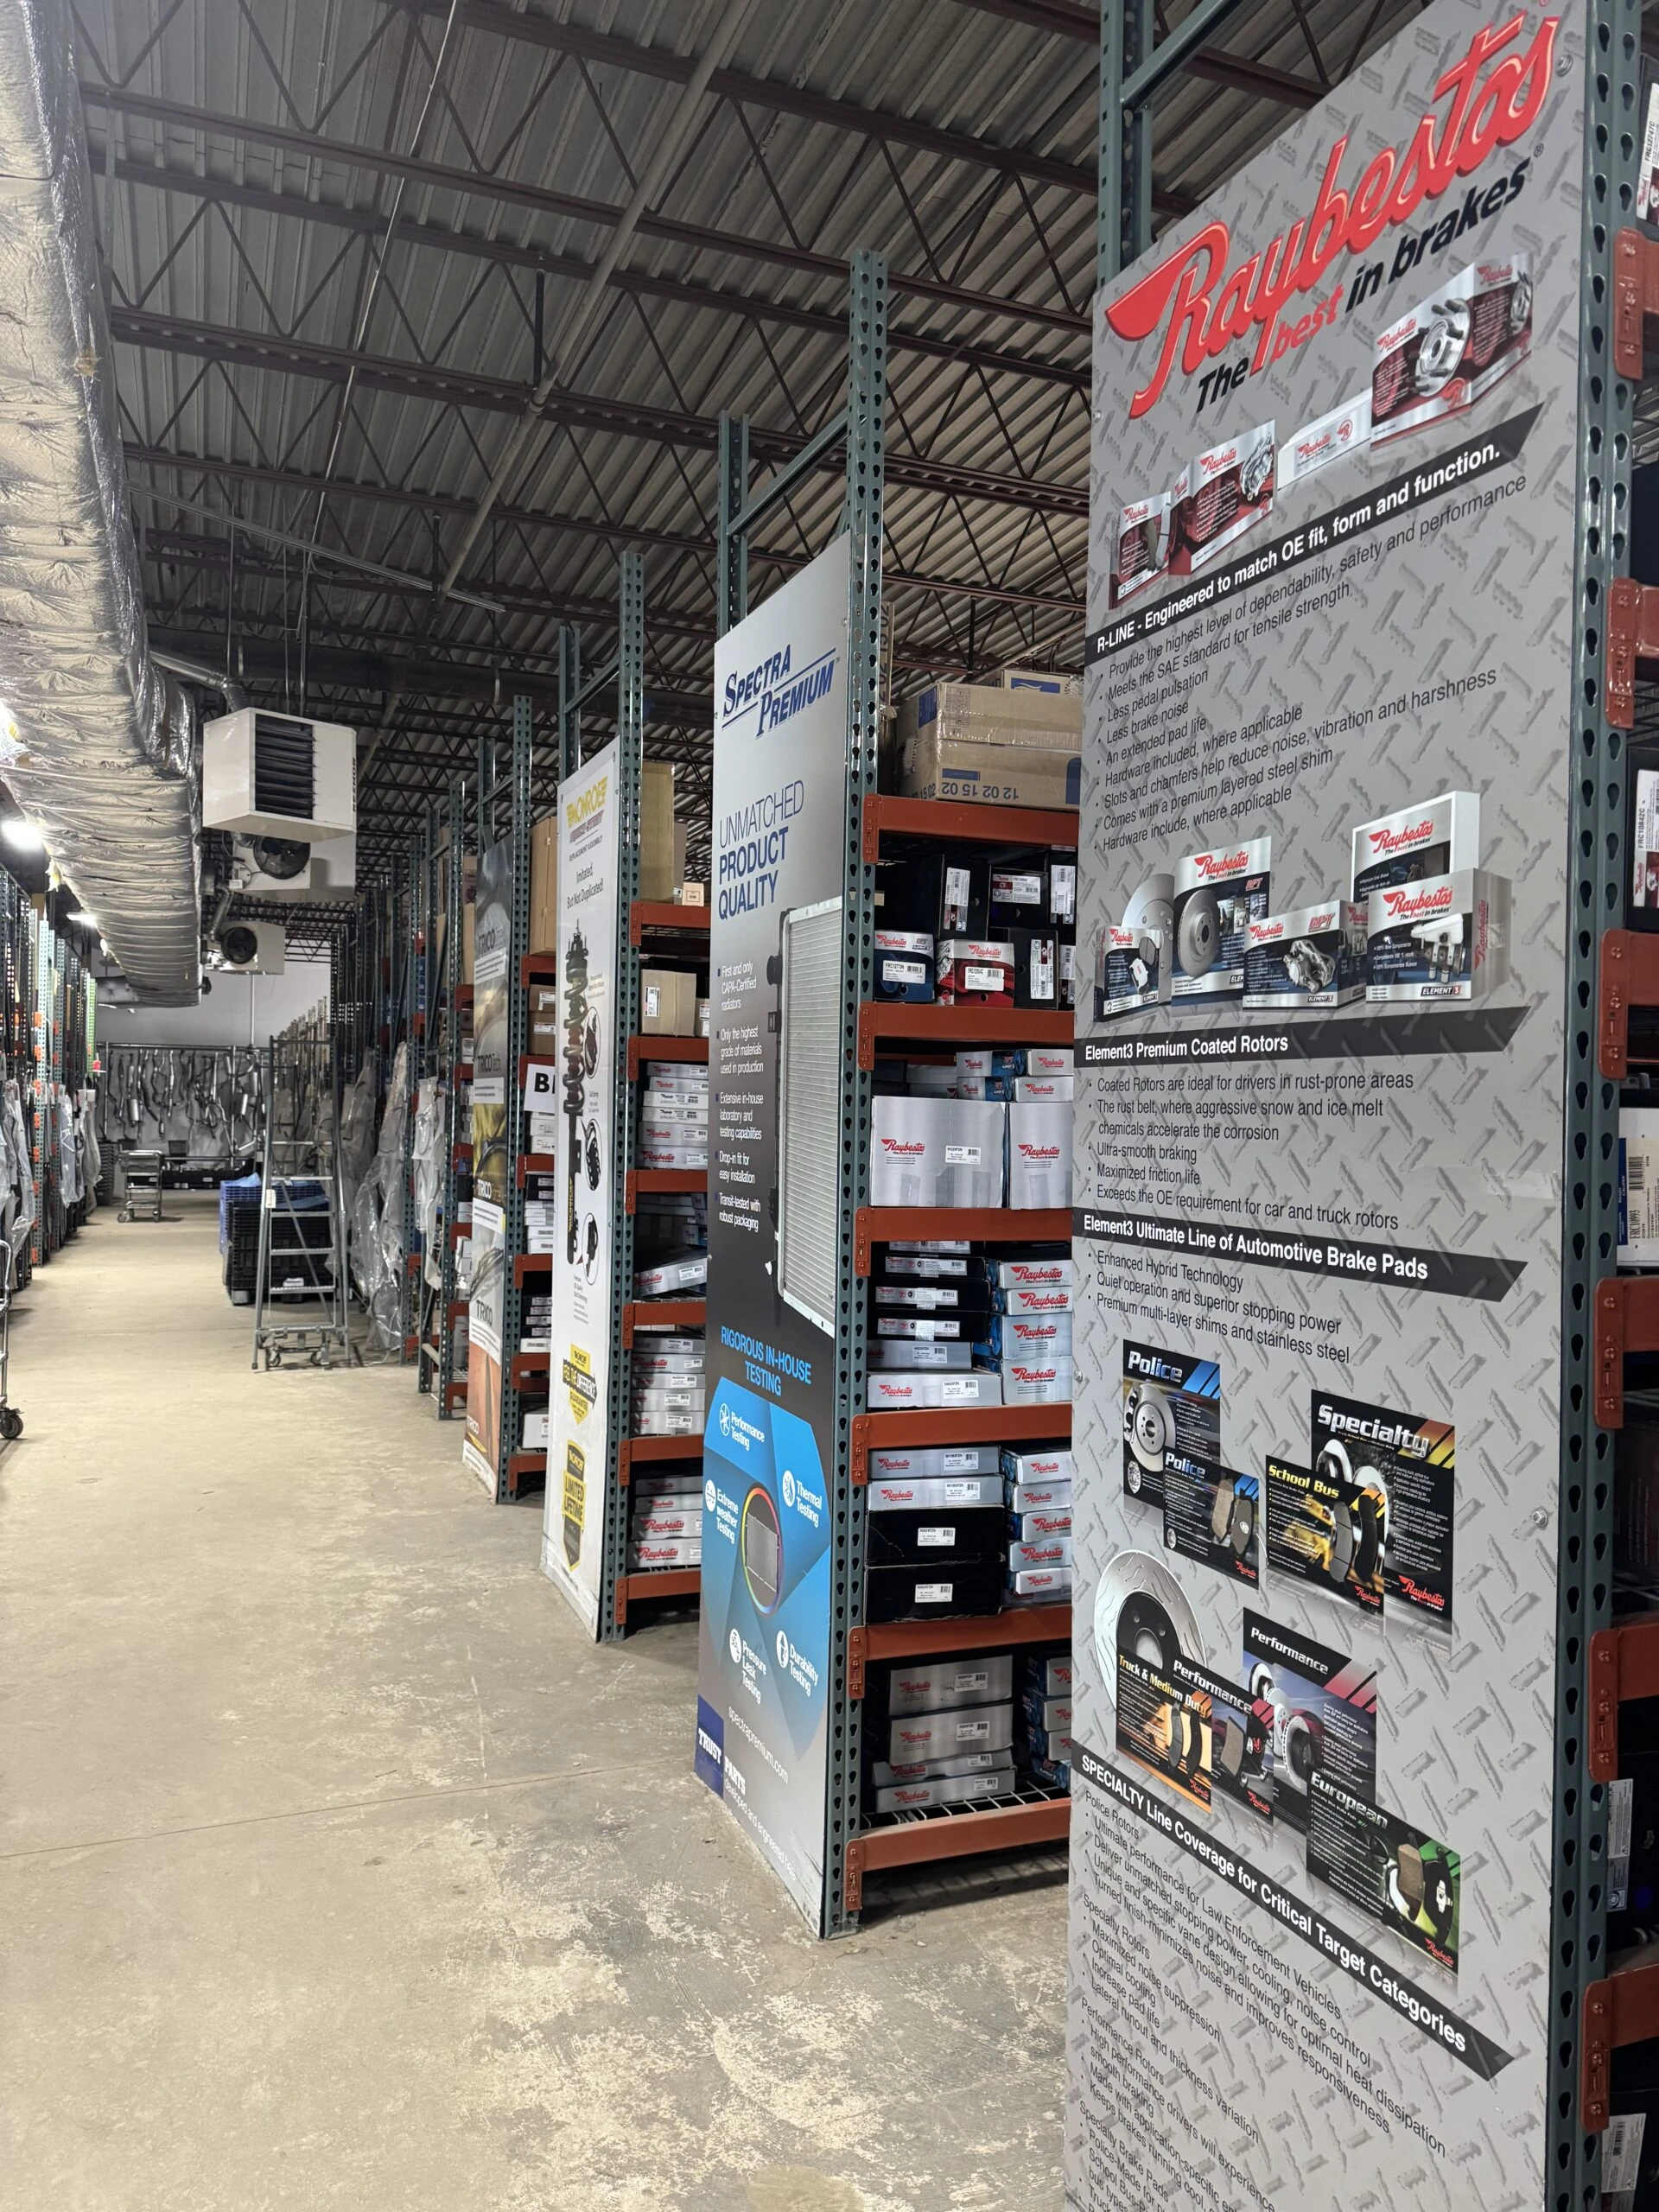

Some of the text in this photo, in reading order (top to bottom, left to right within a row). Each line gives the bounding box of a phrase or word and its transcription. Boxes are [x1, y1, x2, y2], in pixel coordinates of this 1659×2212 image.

[1106, 10, 1560, 419] Raybestos
[1197, 158, 1530, 413] The best in brakes
[1096, 620, 1135, 653] R-LINE
[1144, 580, 1214, 630] Engineered
[1217, 575, 1230, 594] to
[1234, 548, 1277, 586] match
[1281, 535, 1304, 563] OE
[1307, 526, 1327, 550] fit,
[1332, 505, 1370, 537] form
[1376, 481, 1408, 517] and
[1414, 442, 1501, 498] function.
[1108, 473, 1528, 679] Provide the highest level of dependability, safety and performance
[723, 644, 791, 719] SPECTRA
[755, 658, 835, 739] PREMIUM
[1106, 669, 1209, 722] Less pedal pulsation
[720, 779, 804, 848] UNMATCHED
[1369, 819, 1433, 853] Raybestos
[719, 827, 789, 886] PRODUCT
[1194, 851, 1249, 878] Raybestos
[718, 869, 779, 920] QUALITY
[1382, 887, 1452, 917] Raybestos
[733, 962, 741, 976] and
[1084, 1035, 1289, 1060] Element3 Premium Coated Rotors
[720, 1091, 764, 1104] Extensive in-house
[1096, 1073, 1414, 1093] Coated Rotors are ideal for drivers in rust-prone areas
[719, 1126, 762, 1141] testing capabilities
[720, 1109, 753, 1124] laboratory and
[881, 1138, 925, 1152] Raybestos
[1018, 1144, 1060, 1157] Raybestos
[1083, 1214, 1428, 1280] Element3 Ultimate Line of Automotive Brake Pads
[1011, 1266, 1063, 1281] Raybestos
[1096, 1250, 1244, 1294] Enhanced Hybrid Technology
[1018, 1293, 1069, 1306] Raybestos
[1096, 1271, 1342, 1336] Quiet operation and superior stopping power
[1013, 1325, 1057, 1338] Raybestos
[721, 1325, 811, 1385] RIGOROUS IN-HOUSE
[1128, 1351, 1183, 1383] Police
[745, 1360, 782, 1397] TESTING
[1011, 1368, 1057, 1381] Raybestos
[730, 1411, 765, 1443] Performance
[730, 1426, 750, 1452] Testing
[1318, 1404, 1430, 1459] Specialty
[1166, 1452, 1205, 1478] Police
[1268, 1465, 1340, 1498] School Bus
[716, 1488, 739, 1514] Extreme
[796, 1479, 822, 1510] Thermal
[716, 1506, 738, 1529] weather
[796, 1497, 819, 1528] Testing
[716, 1517, 735, 1545] Testing
[1398, 1574, 1446, 1606] Raybestos
[742, 1640, 767, 1675] Pressure
[742, 1656, 756, 1680] Leak
[790, 1643, 819, 1687] Durability
[1251, 1626, 1329, 1675] Performance
[742, 1669, 762, 1705] Testing
[790, 1660, 811, 1697] Testing
[1119, 1654, 1208, 1718] Truck & Medium Duty
[1173, 1660, 1253, 1714] Performance
[698, 1727, 746, 1796] TRUST PARTS
[728, 1706, 789, 1785] spectrapremium.com
[1084, 1788, 1140, 1842] Police Rotors
[1311, 1771, 1389, 1829] European
[1081, 1752, 1466, 2054] SPECIALTY Line Coverage for Critical Target Categories
[1093, 1813, 1341, 2022] Ultimate performance for Law Enforcement Vehicles
